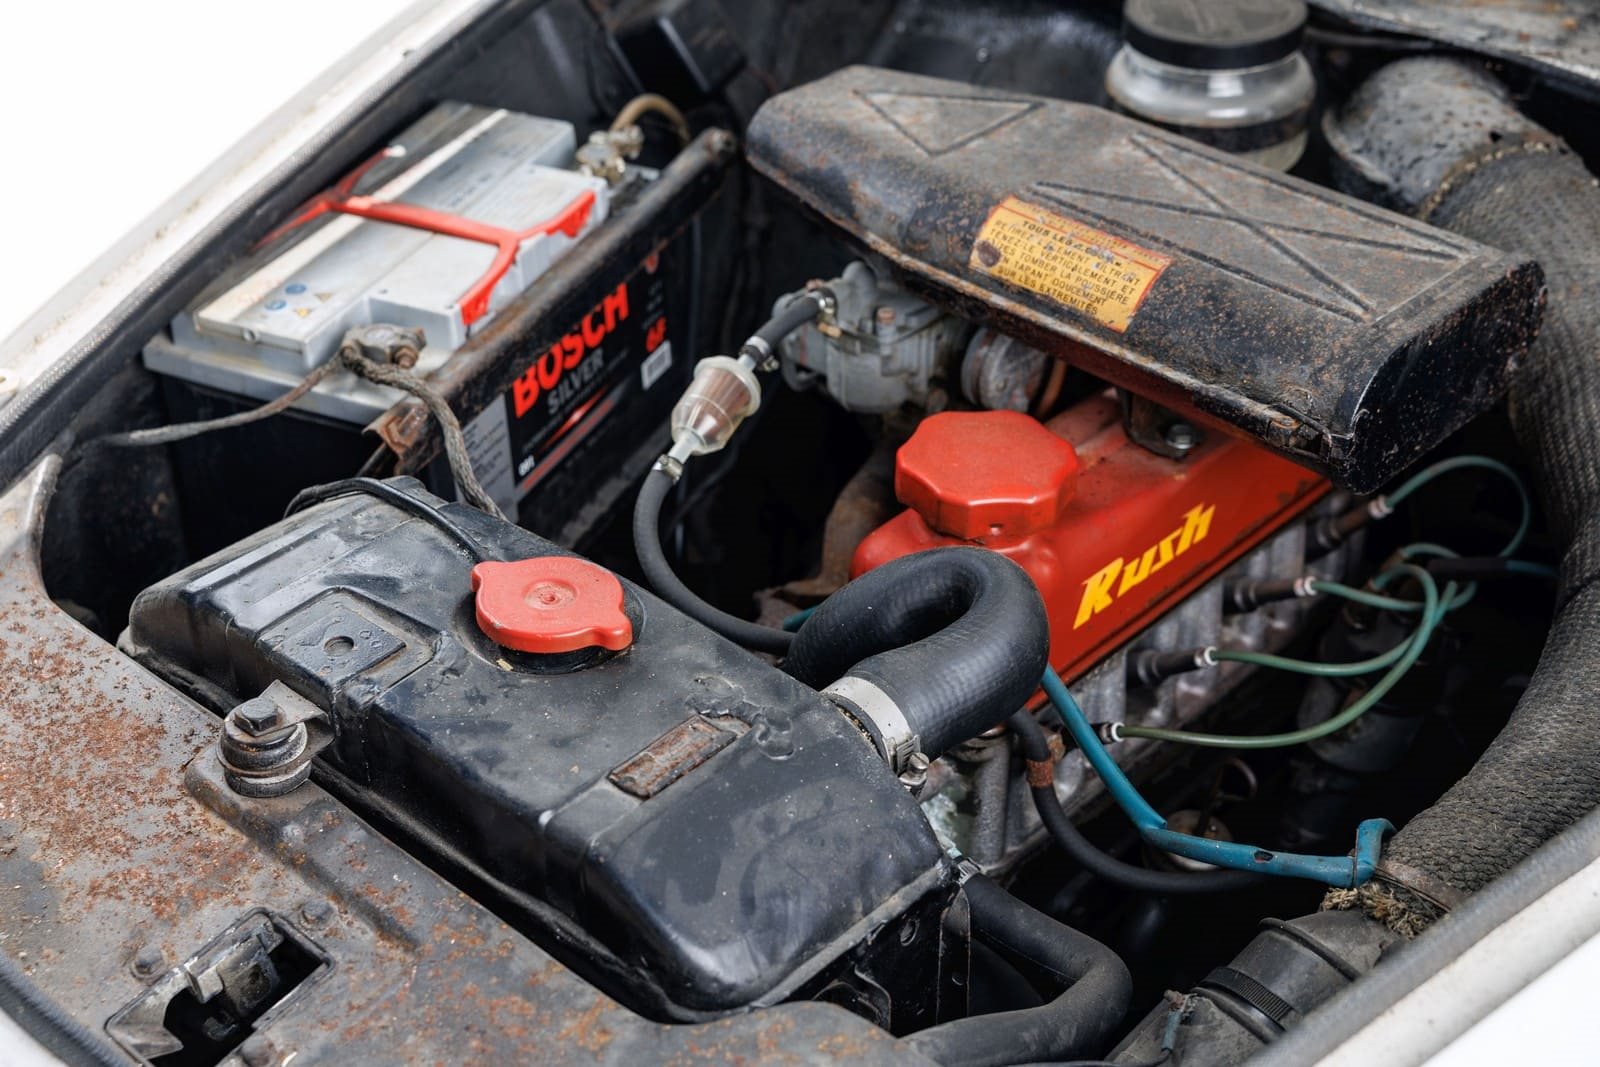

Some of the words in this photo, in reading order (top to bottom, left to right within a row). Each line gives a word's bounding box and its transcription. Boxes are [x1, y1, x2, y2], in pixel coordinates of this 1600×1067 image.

[1014, 260, 1048, 281] TAPANT
[1053, 277, 1106, 306] DOUCEMENT
[1059, 269, 1073, 280] LA
[1120, 284, 1136, 296] ET
[512, 282, 629, 418] BOSCH
[548, 348, 605, 415] SILVER
[1073, 502, 1216, 630] Rush
